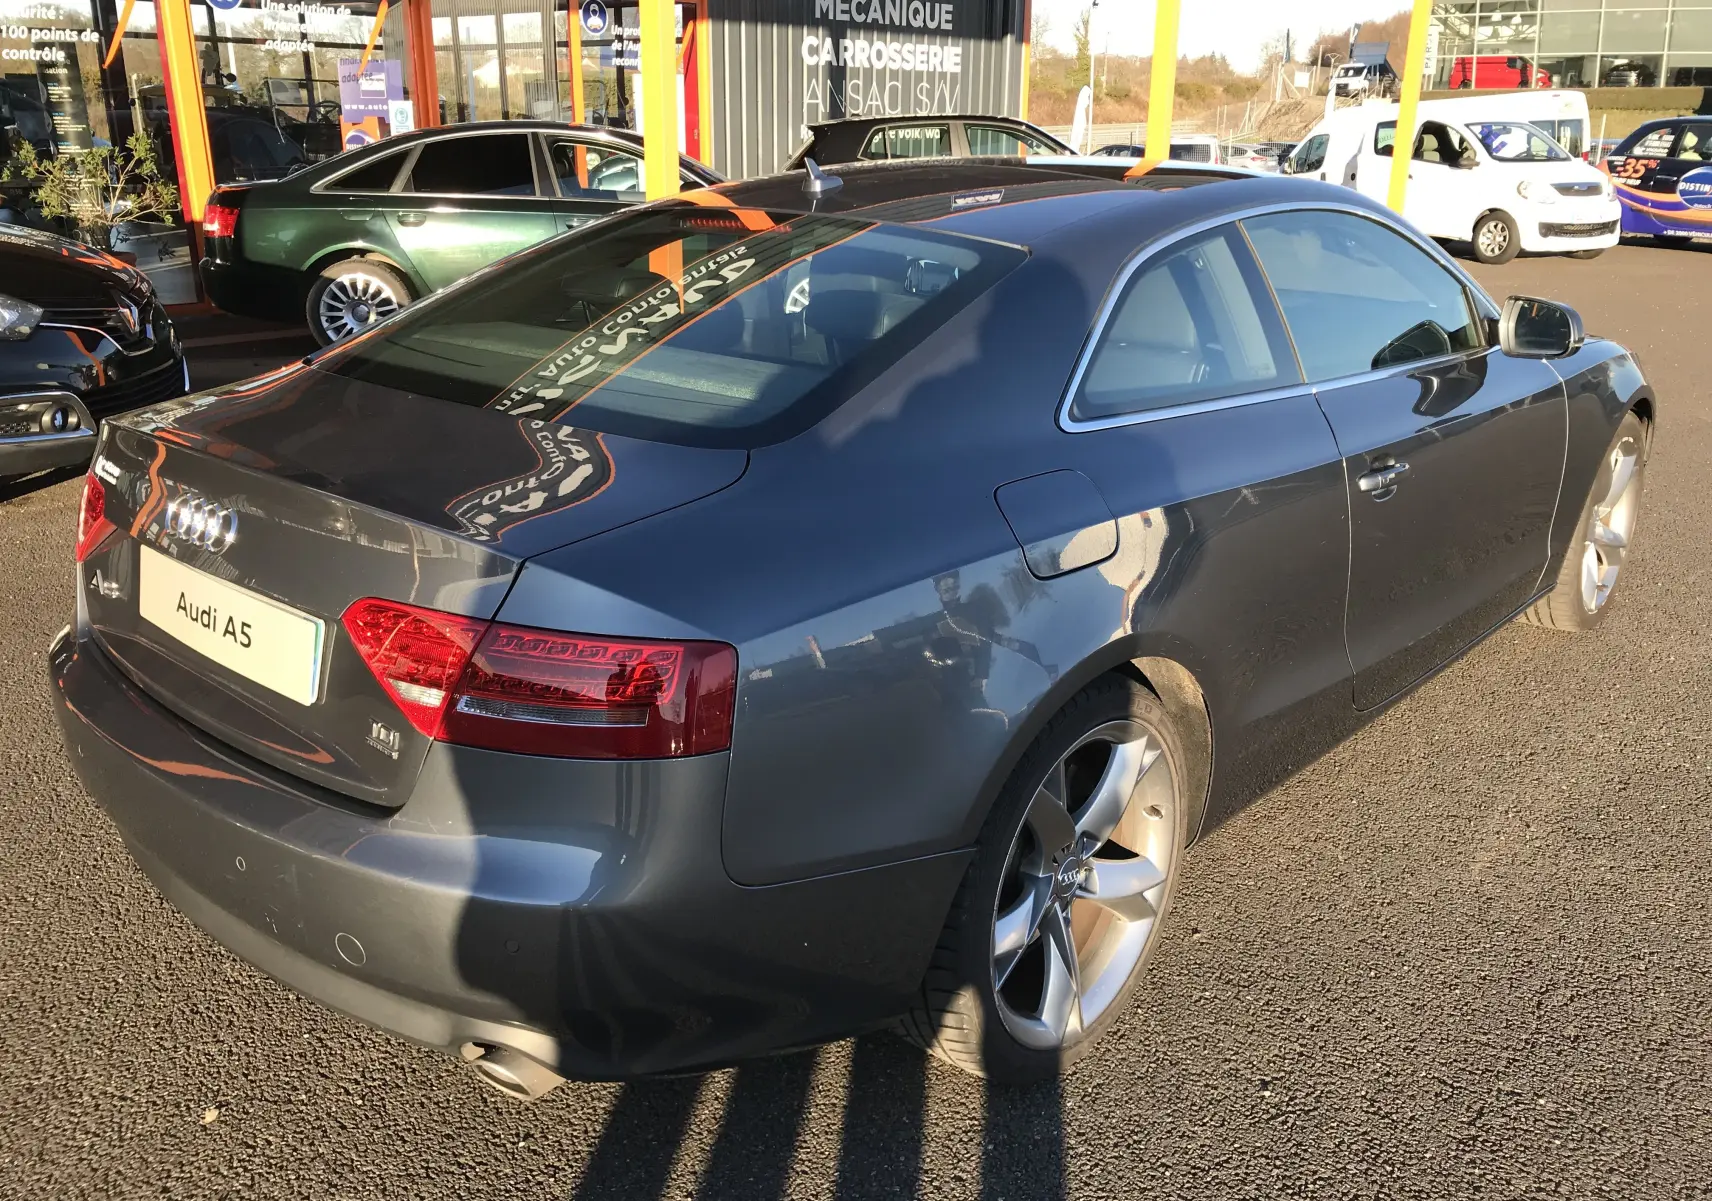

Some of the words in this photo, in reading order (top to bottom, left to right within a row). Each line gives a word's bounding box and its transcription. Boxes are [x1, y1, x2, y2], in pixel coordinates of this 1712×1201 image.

[261, 0, 285, 11] Une
[287, 1, 335, 15] solution
[337, 5, 351, 16] de
[1, 25, 28, 39] 100
[31, 27, 79, 42] points
[81, 28, 100, 42] de
[611, 25, 622, 35] Un
[265, 37, 315, 52] adaptée
[611, 40, 622, 51] de
[2, 47, 65, 61] contrôle
[801, 35, 962, 73] CARROSSERIE
[803, 78, 902, 114] ANSAC
[176, 591, 217, 633] Audi
[222, 615, 252, 649] A5
[369, 717, 400, 750] TDI
